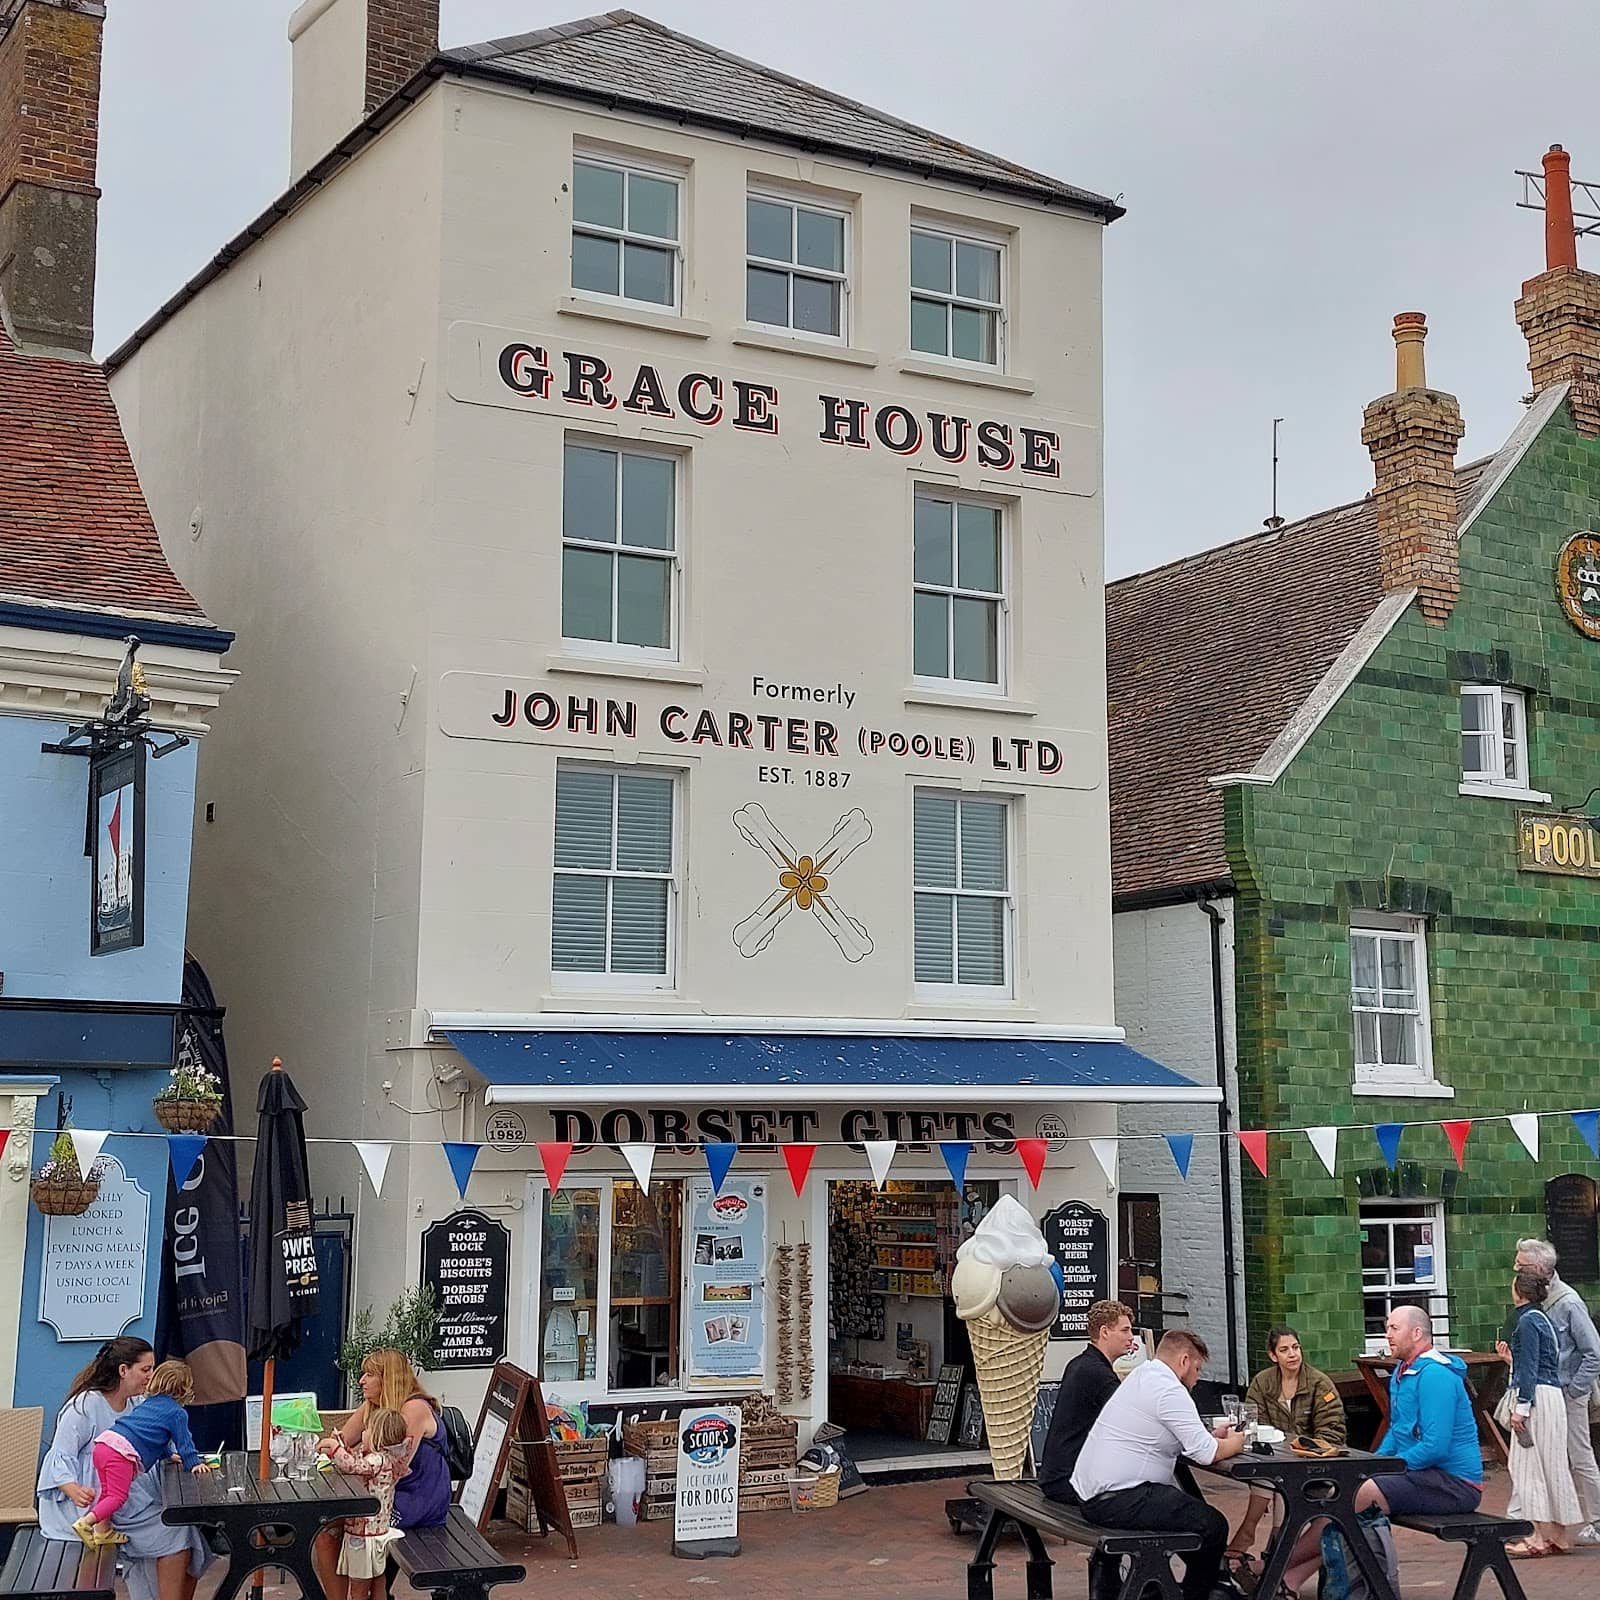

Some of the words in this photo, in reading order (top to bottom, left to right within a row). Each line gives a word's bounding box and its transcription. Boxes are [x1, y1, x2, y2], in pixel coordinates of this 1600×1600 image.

[497, 342, 779, 435] GRACE
[817, 393, 1061, 478] HOUSE
[752, 677, 856, 709] Formerly
[491, 689, 637, 738] JOHN
[660, 705, 839, 757] CARTER
[858, 726, 975, 763] (POOLE)
[992, 736, 1064, 774] LTD
[758, 766, 796, 785] EST.
[804, 770, 851, 788] 1887
[495, 1120, 517, 1129] Est.
[488, 1129, 524, 1140] 1982
[549, 1108, 820, 1156] DORSET
[840, 1110, 1020, 1155] GIFTS
[96, 1192, 124, 1202] SHLY
[1058, 1219, 1094, 1228] DORSET
[71, 1226, 112, 1236] LUNCH
[115, 1226, 124, 1235] &
[1063, 1228, 1090, 1236] GIFTS
[448, 1232, 487, 1242] POOLE
[52, 1243, 103, 1254] EVENING
[106, 1242, 142, 1253] MEALS
[450, 1242, 484, 1251] ROCK
[1058, 1242, 1094, 1251] DORSET
[1064, 1251, 1088, 1259] BEER
[55, 1261, 62, 1270] 7
[65, 1261, 92, 1270] DAYS
[94, 1260, 102, 1270] A
[104, 1259, 135, 1270] WEEK
[440, 1258, 492, 1268] MOORE'S
[439, 1268, 492, 1278] BISCUITS
[1063, 1265, 1091, 1274] LOCAL
[56, 1277, 93, 1287] USING
[97, 1276, 131, 1287] LOCAL
[442, 1284, 489, 1295] DORSET
[66, 1293, 120, 1304] PRODUCE
[445, 1294, 485, 1305] KNOBS
[1064, 1299, 1090, 1307] MEAD
[1060, 1313, 1089, 1322] DORSE
[439, 1325, 488, 1336] FUDGES,
[442, 1337, 473, 1347] JAMS
[475, 1336, 484, 1346] &
[433, 1347, 493, 1359] CHUTNEYS
[702, 1472, 729, 1488] CREAM
[681, 1489, 701, 1507] FOR
[705, 1487, 734, 1505] DOGS
